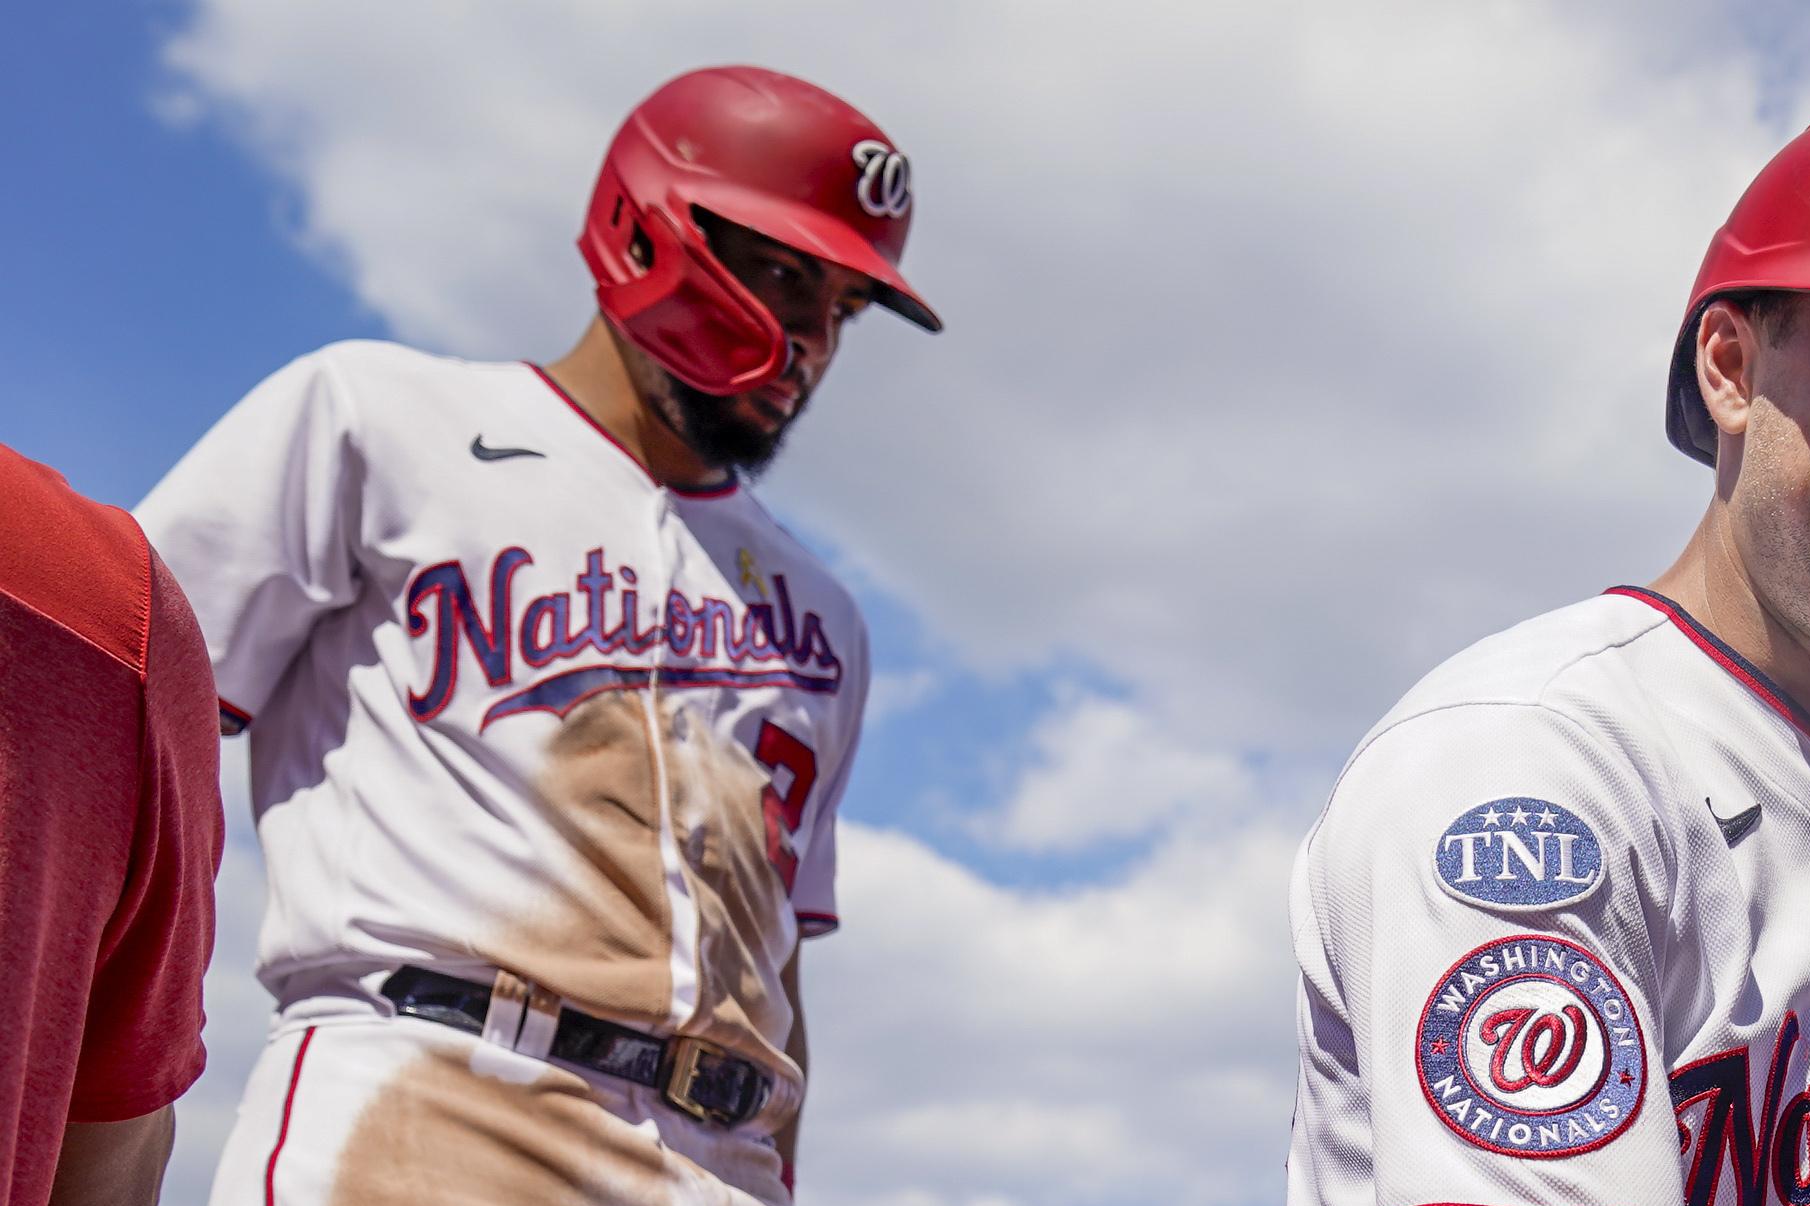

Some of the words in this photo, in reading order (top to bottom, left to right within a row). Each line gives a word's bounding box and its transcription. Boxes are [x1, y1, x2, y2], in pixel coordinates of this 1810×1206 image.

[406, 546, 842, 723] Nationals
[1444, 829, 1594, 885] TNL
[1436, 945, 1635, 1047] WASHINGTON
[1433, 1074, 1622, 1146] NATIONALS
